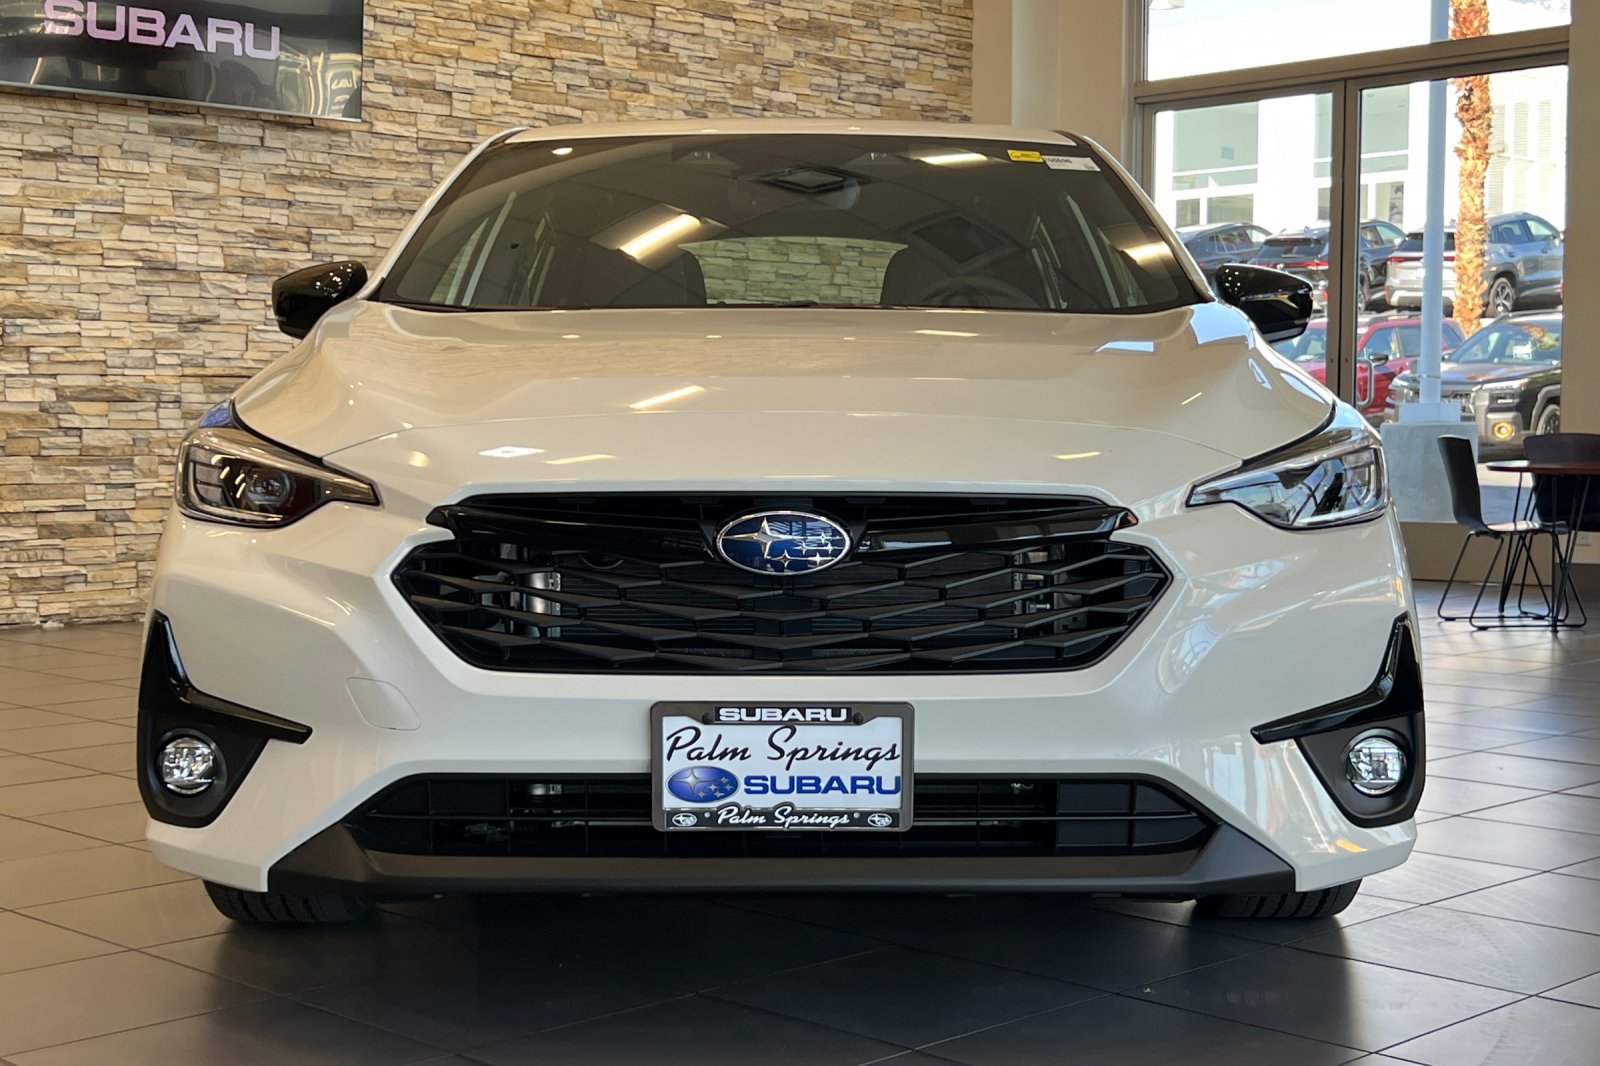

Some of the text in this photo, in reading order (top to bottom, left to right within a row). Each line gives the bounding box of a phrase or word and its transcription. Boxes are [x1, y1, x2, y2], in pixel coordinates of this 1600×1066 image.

[44, 0, 280, 60] SUBARU
[719, 707, 848, 722] SUBARU
[666, 724, 900, 772] Palm Springs
[743, 774, 901, 796] SUBARU
[717, 805, 850, 829] Palm Springs
